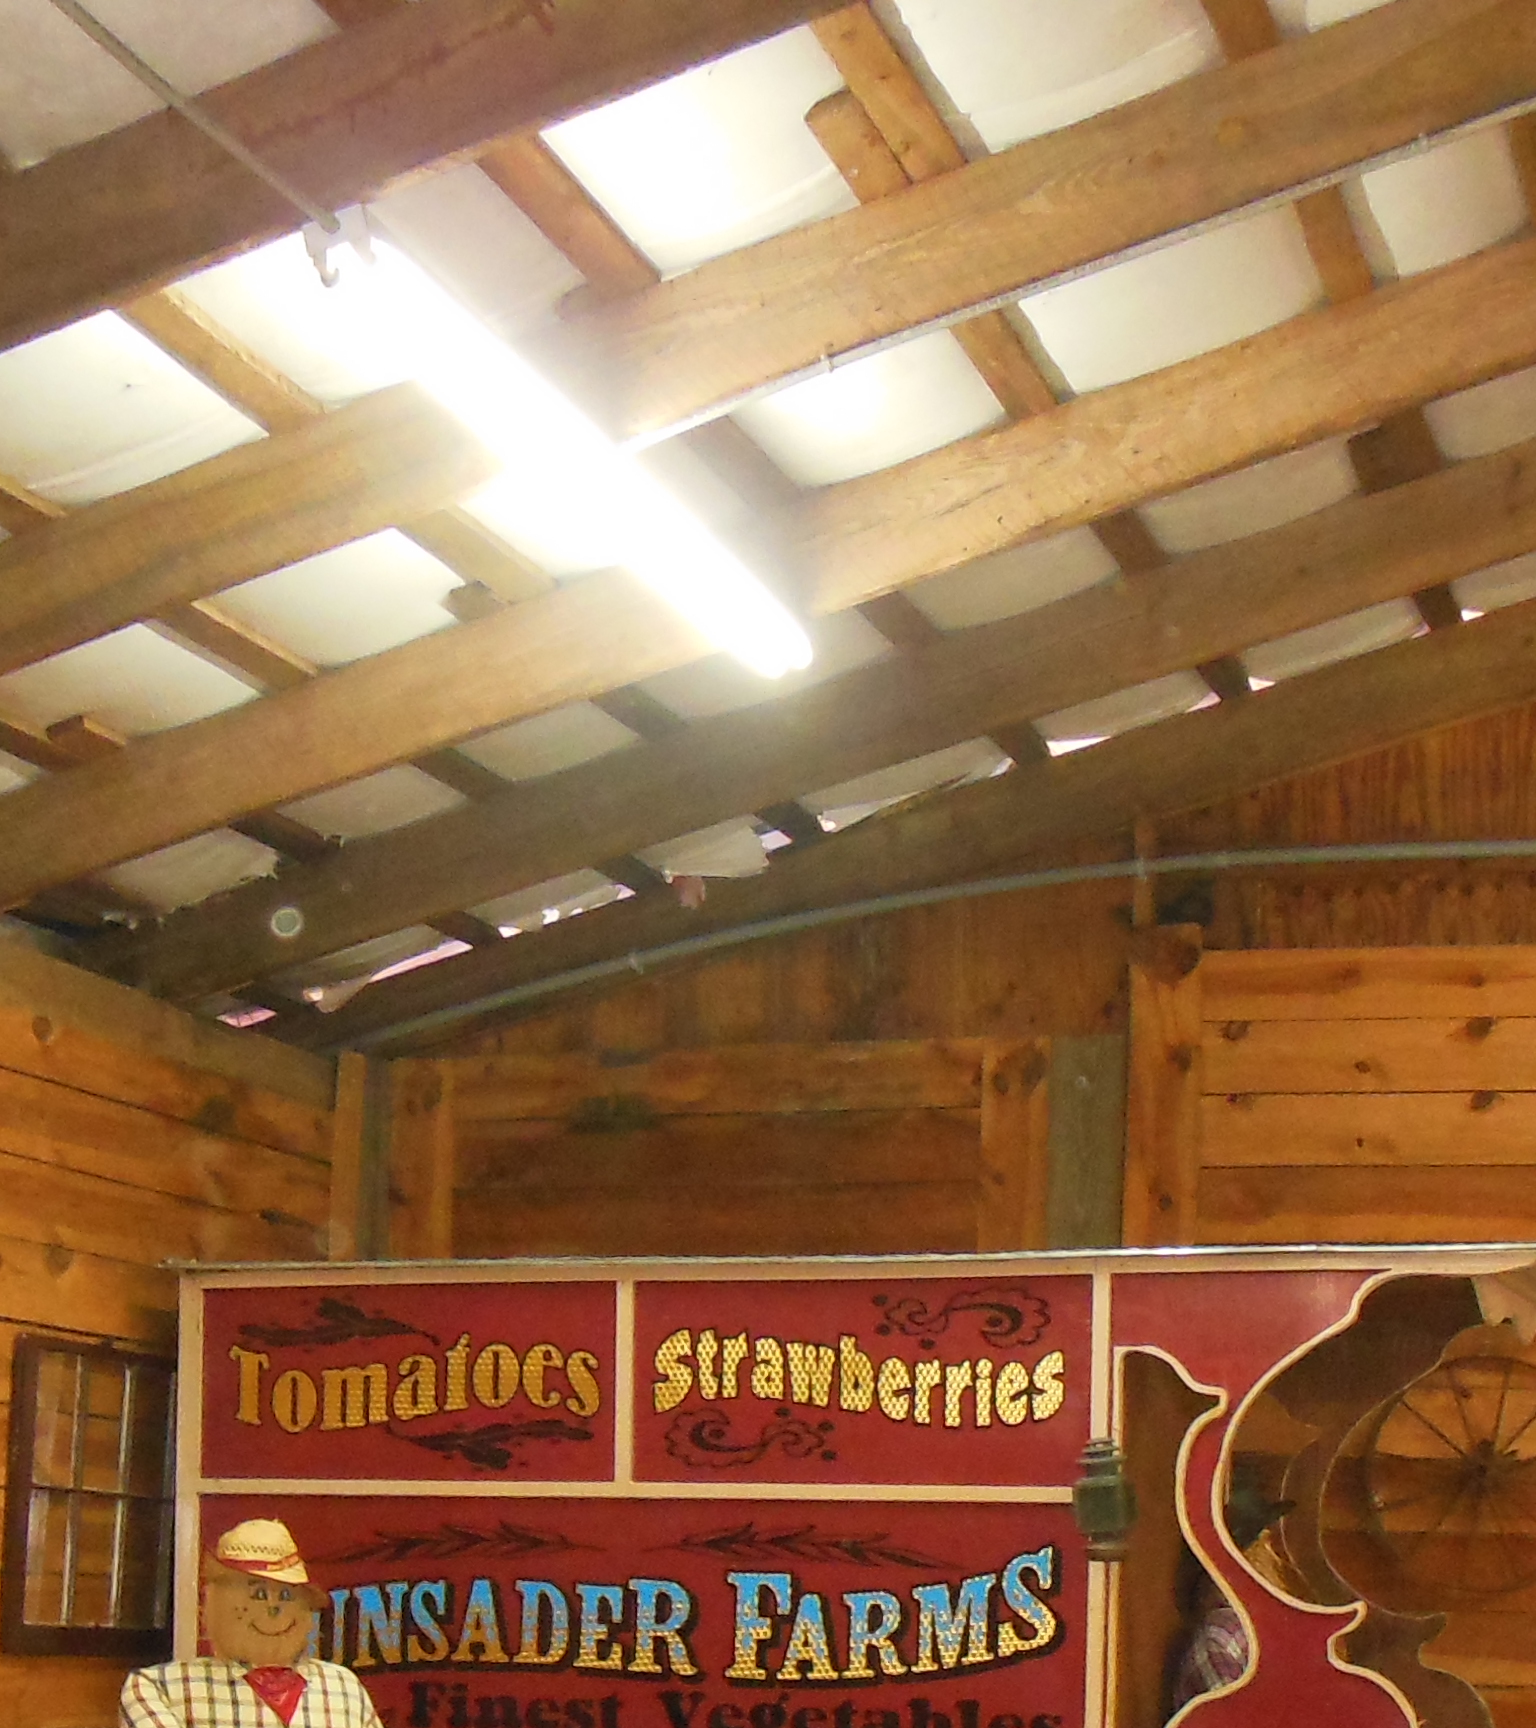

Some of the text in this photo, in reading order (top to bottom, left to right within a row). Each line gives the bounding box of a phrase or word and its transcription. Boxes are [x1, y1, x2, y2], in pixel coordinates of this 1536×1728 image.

[228, 1331, 601, 1434] Tomatoes
[652, 1326, 1066, 1428] Strawberries
[725, 1545, 1057, 1682] FARMS
